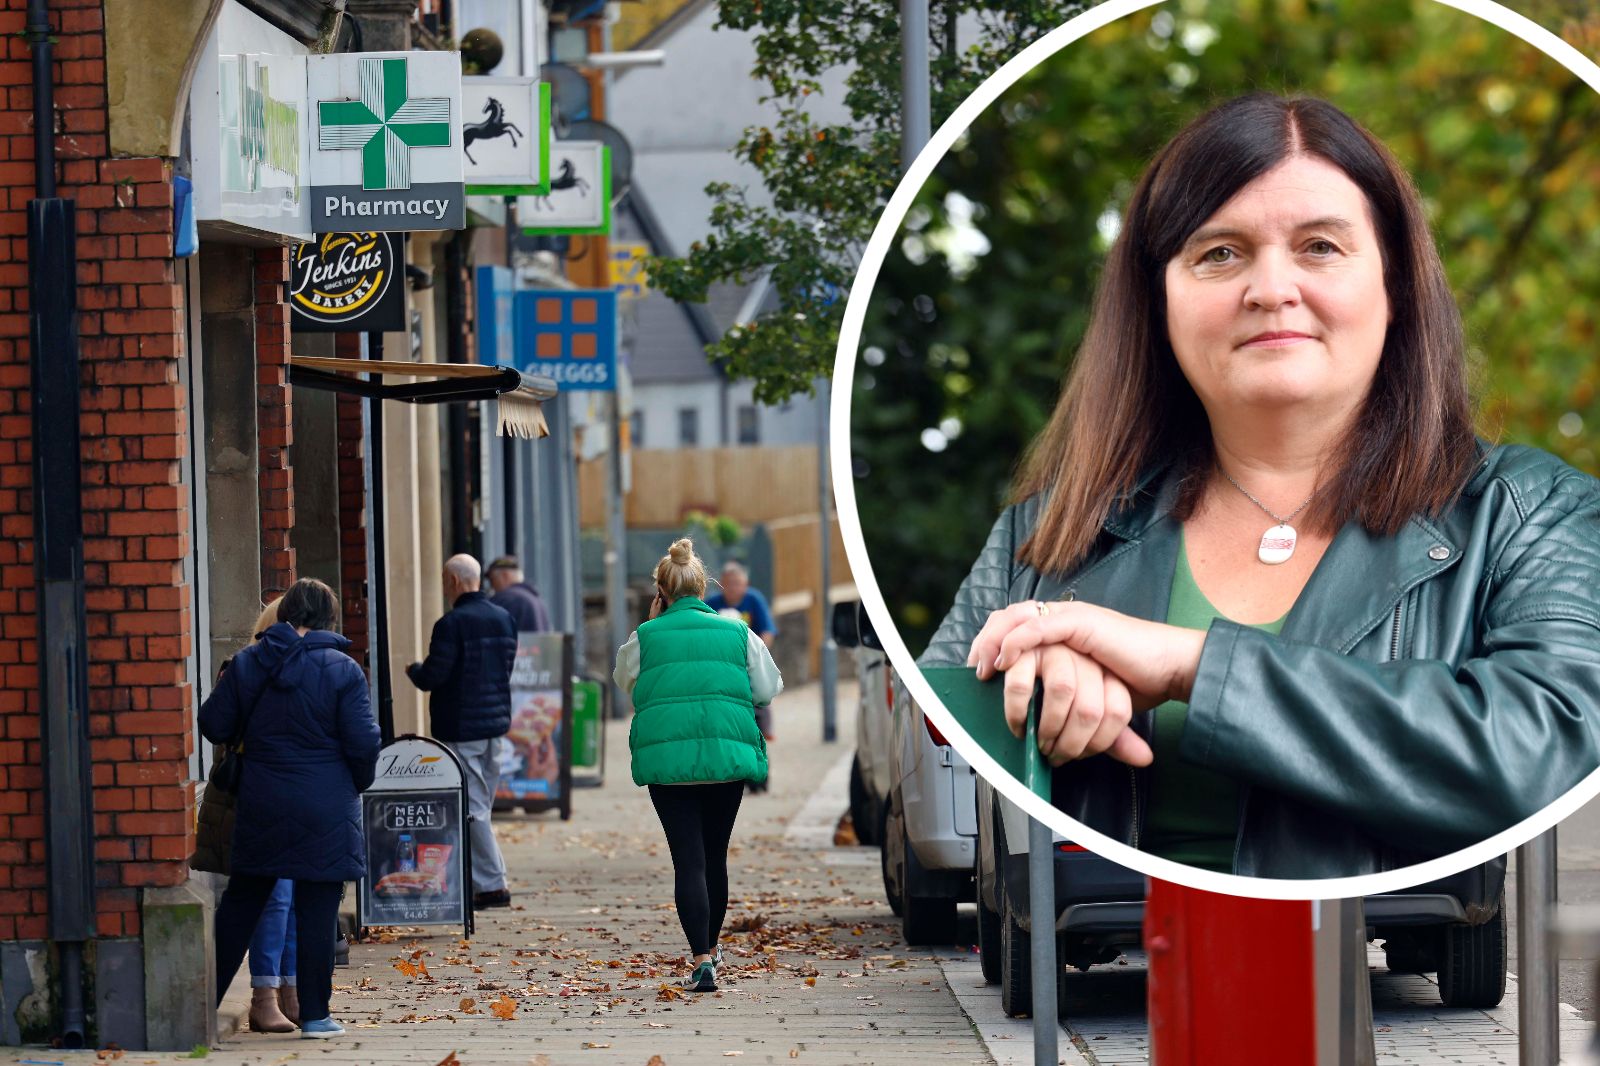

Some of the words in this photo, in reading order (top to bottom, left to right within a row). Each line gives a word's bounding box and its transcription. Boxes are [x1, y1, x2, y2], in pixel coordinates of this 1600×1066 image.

[325, 195, 450, 220] Pharmacy
[291, 241, 382, 296] Jenkins
[312, 279, 373, 308] BAKERY
[323, 281, 343, 291] SINCE
[524, 362, 609, 384] GREGGS
[376, 754, 436, 779] Jenkins
[395, 804, 435, 816] MEAL
[395, 815, 434, 827] DEAL
[404, 910, 429, 919] £4.65
